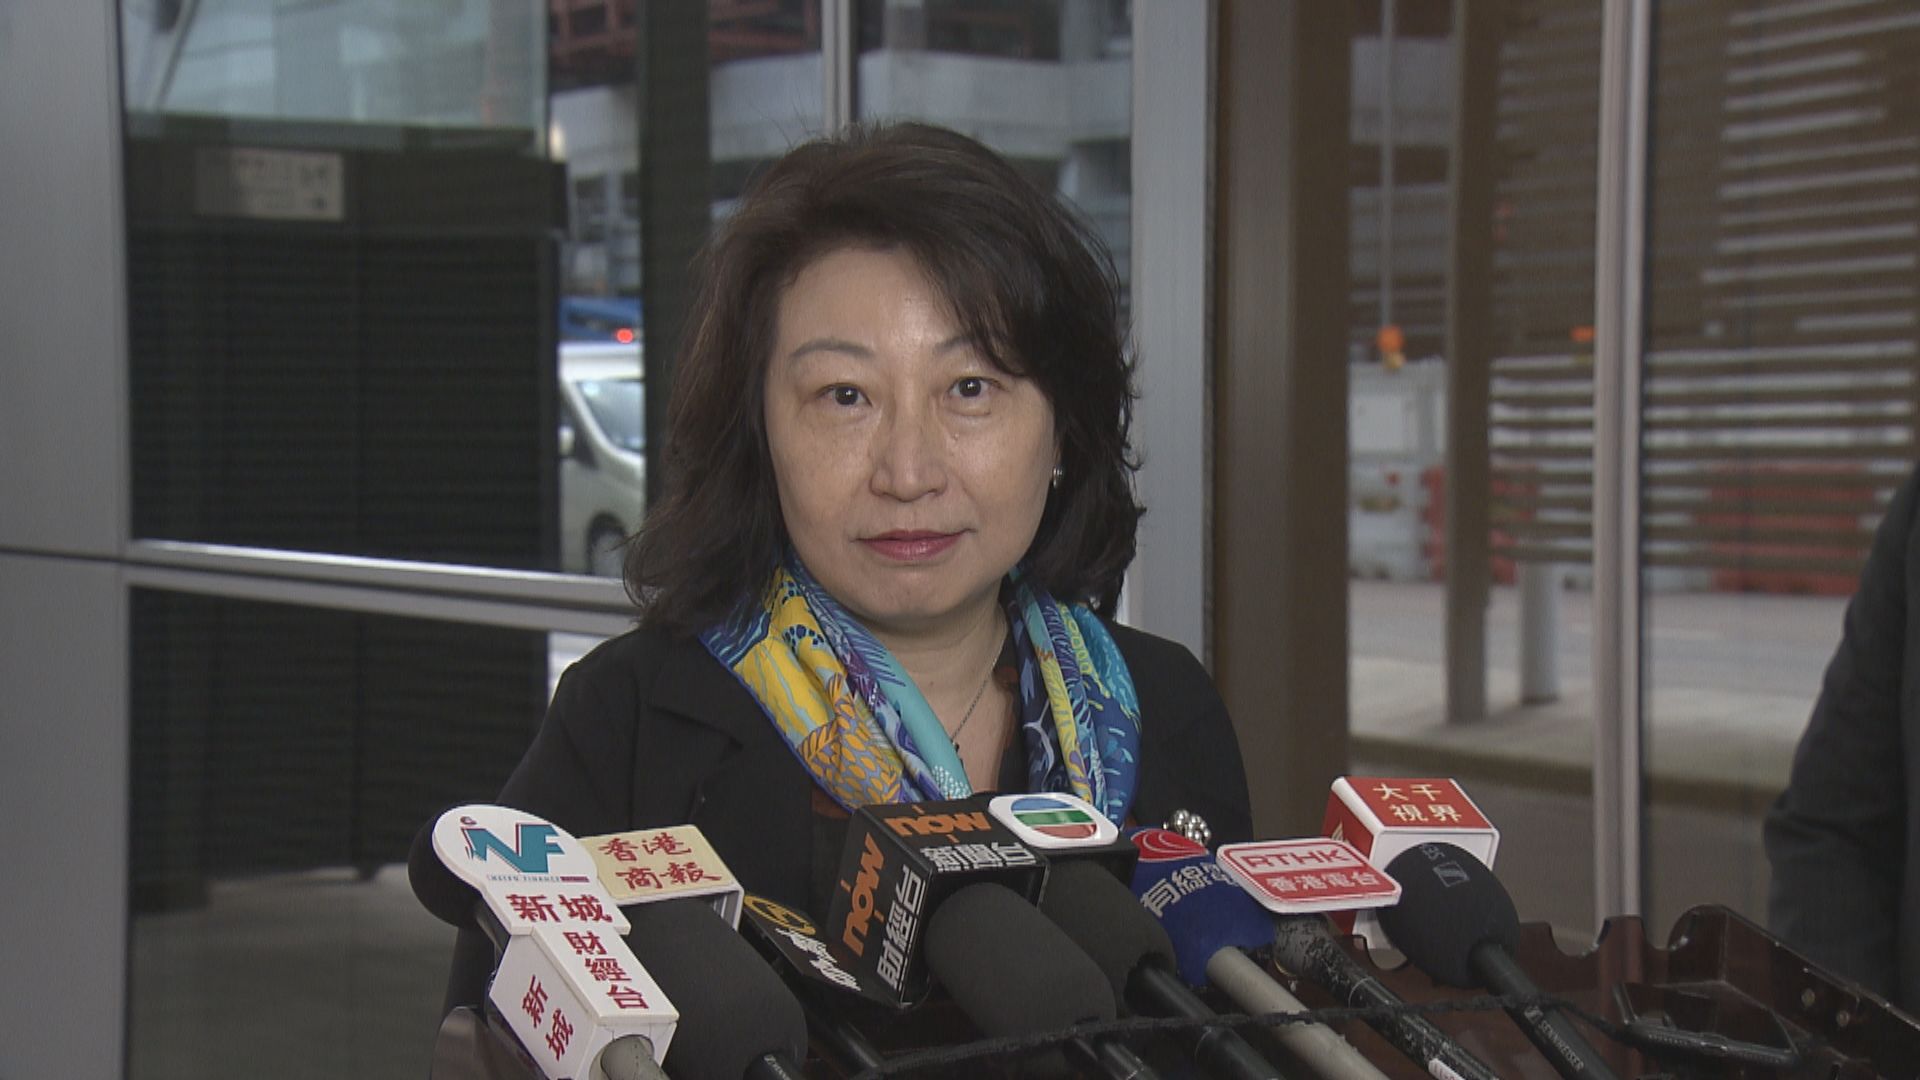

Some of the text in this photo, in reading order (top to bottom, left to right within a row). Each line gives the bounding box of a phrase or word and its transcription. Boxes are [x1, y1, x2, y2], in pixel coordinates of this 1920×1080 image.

[1373, 783, 1442, 801] 大千
[884, 808, 991, 840] now
[597, 831, 692, 862] 香港
[1241, 850, 1350, 868] RTHK
[615, 862, 722, 890] 商報
[1266, 871, 1380, 893] 香港電台
[506, 894, 613, 922] 新城
[841, 832, 885, 957] now
[876, 864, 926, 991] 財經台
[563, 931, 649, 1011] 財經台
[521, 974, 573, 1061] 新城
